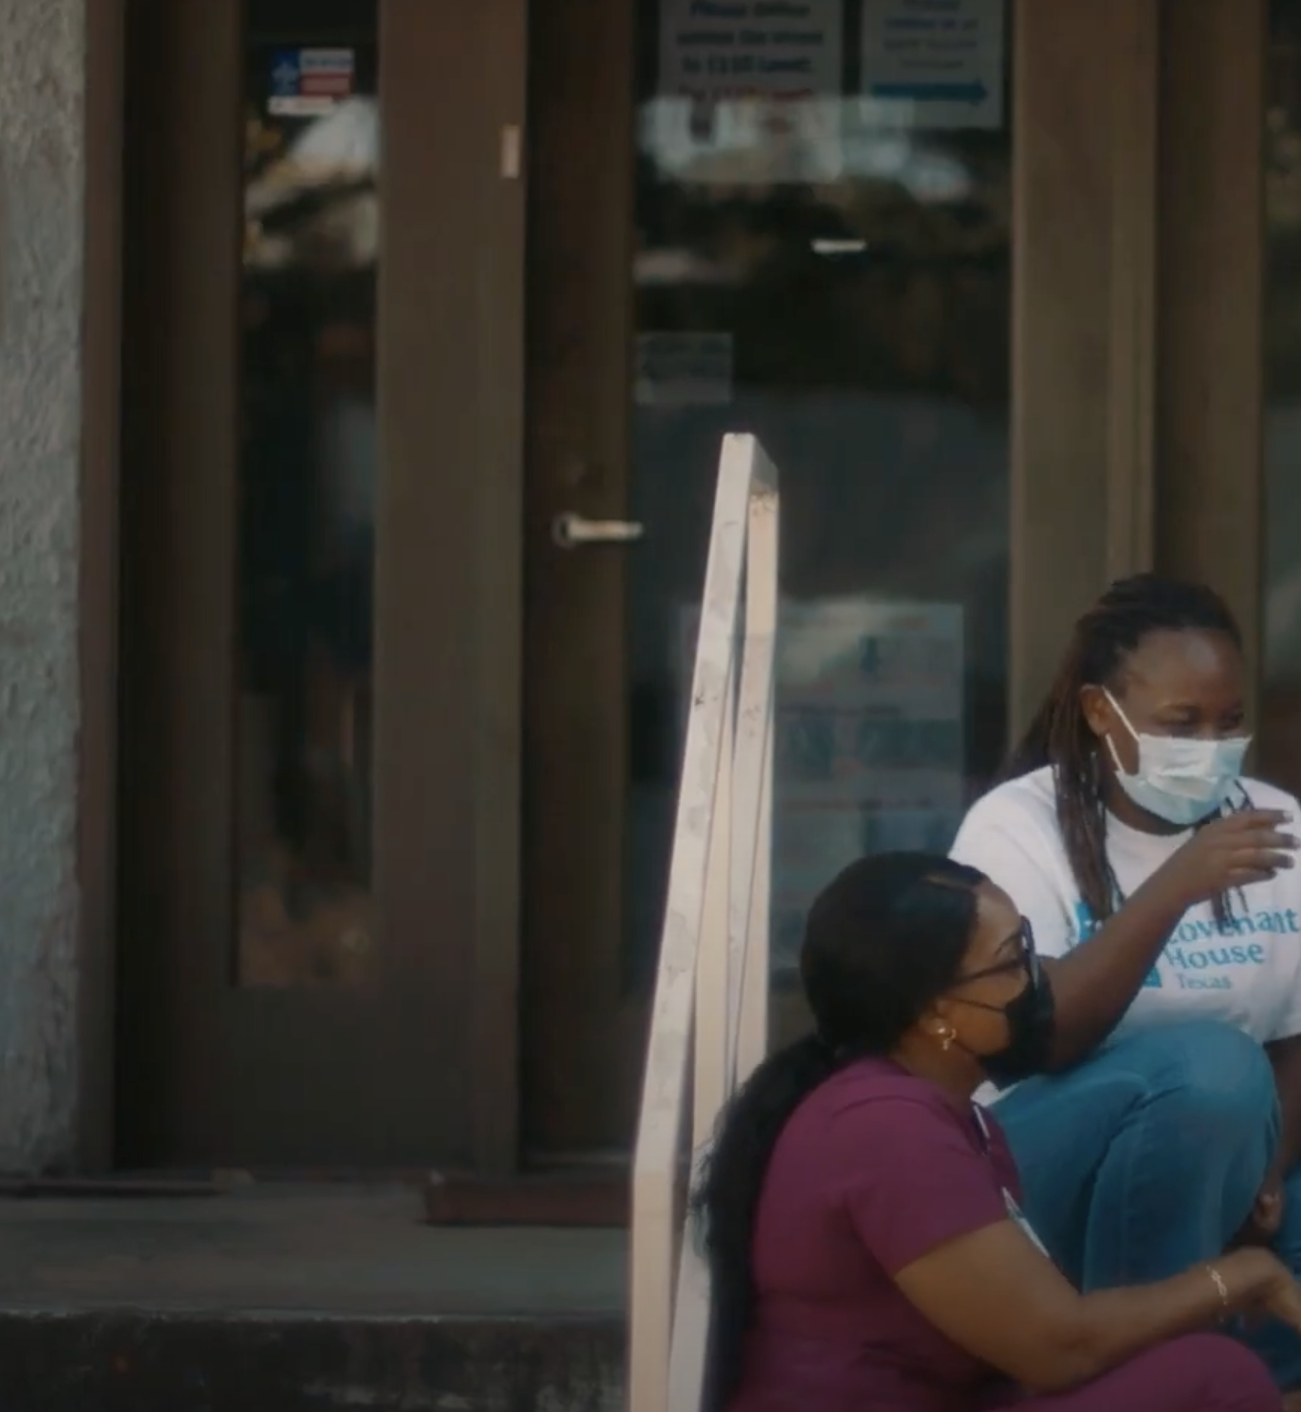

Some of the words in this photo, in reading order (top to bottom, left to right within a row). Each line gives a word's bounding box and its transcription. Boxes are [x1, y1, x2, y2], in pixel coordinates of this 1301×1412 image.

[1168, 907, 1301, 945] ovenant
[1163, 943, 1267, 970] House
[1175, 973, 1233, 989] Texas
